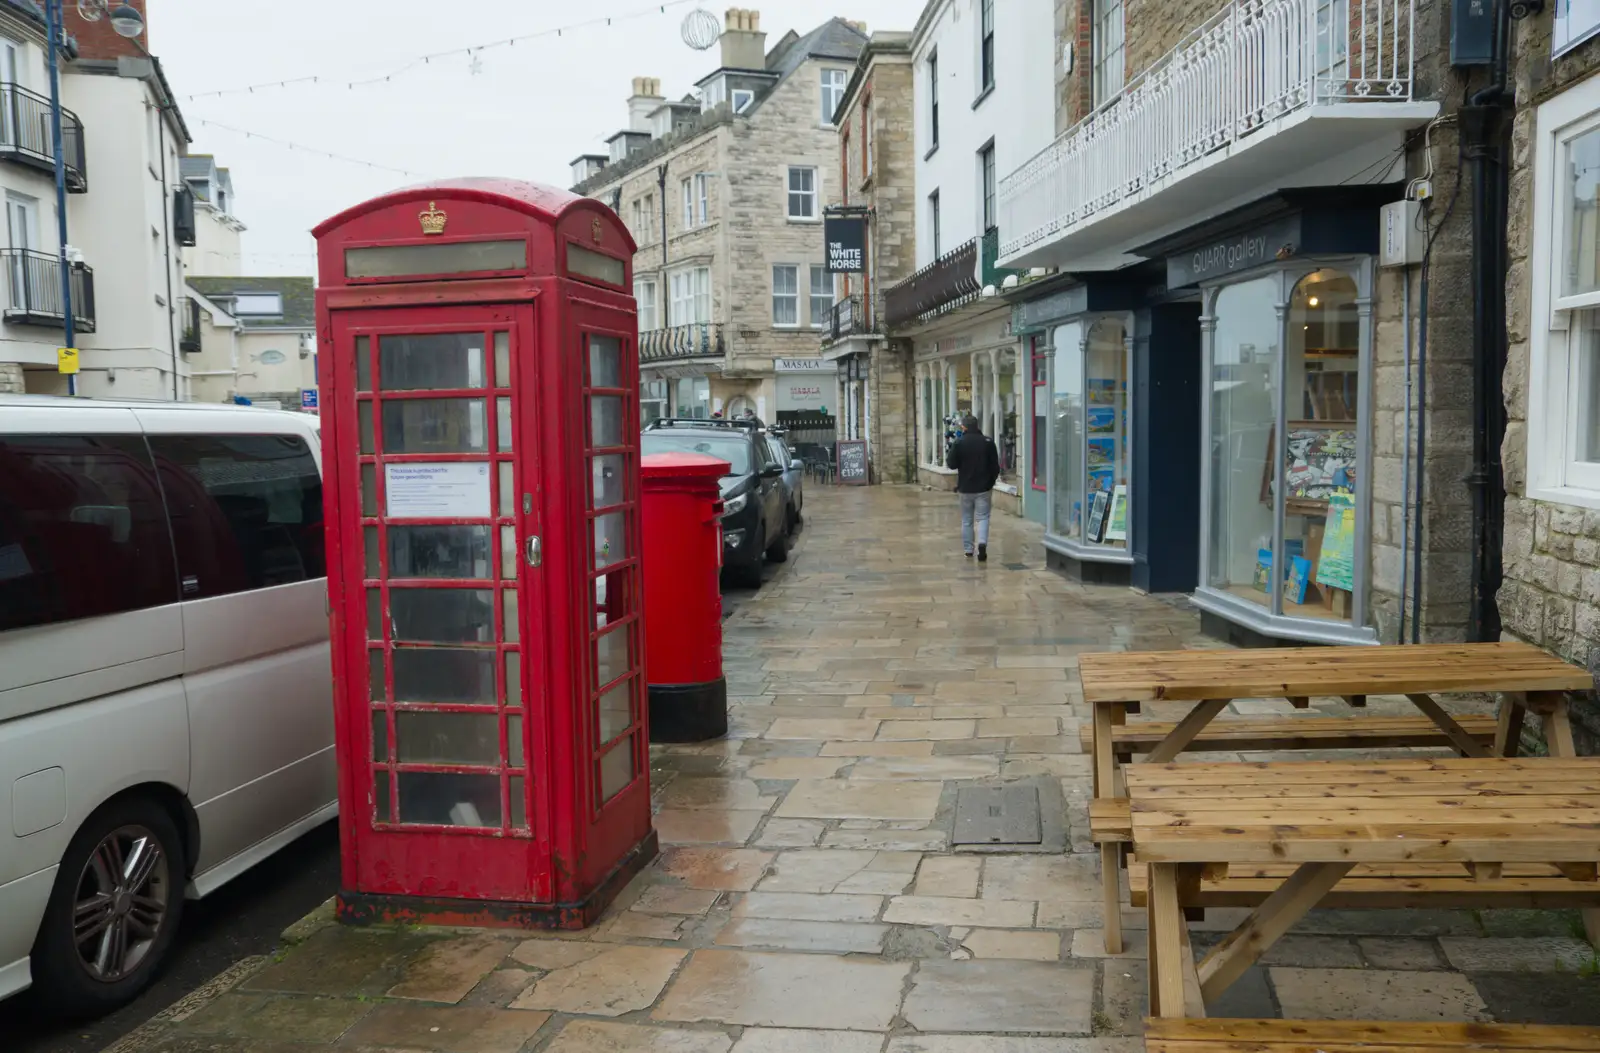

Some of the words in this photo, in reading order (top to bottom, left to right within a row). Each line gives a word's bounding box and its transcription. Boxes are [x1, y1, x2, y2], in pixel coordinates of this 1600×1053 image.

[829, 248, 861, 259] WHITE
[1193, 245, 1226, 273] QUARR
[1227, 235, 1267, 269] gallery
[829, 259, 861, 269] HORSE
[782, 360, 820, 369] MASALA
